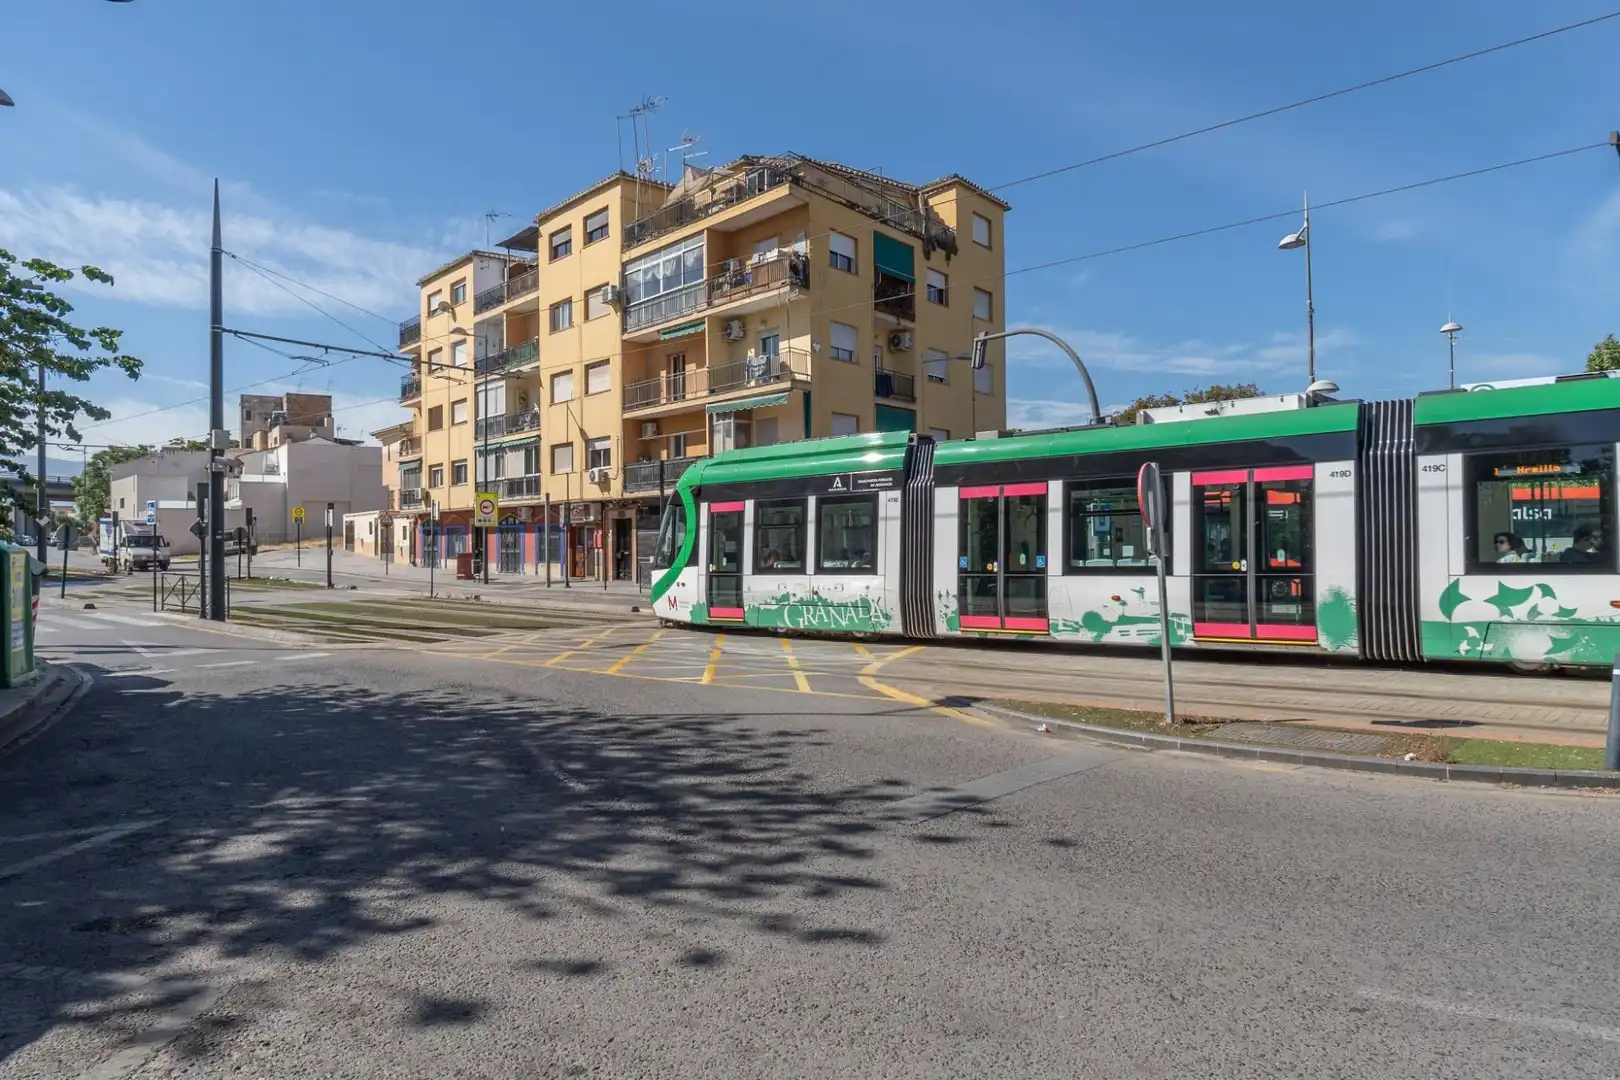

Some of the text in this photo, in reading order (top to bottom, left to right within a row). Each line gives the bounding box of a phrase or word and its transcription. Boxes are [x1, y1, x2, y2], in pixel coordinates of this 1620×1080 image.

[1329, 470, 1352, 478] 419D
[1421, 464, 1446, 472] 419C
[1512, 506, 1553, 520] alsa
[668, 595, 678, 611] M
[784, 595, 884, 629] GRANADA
